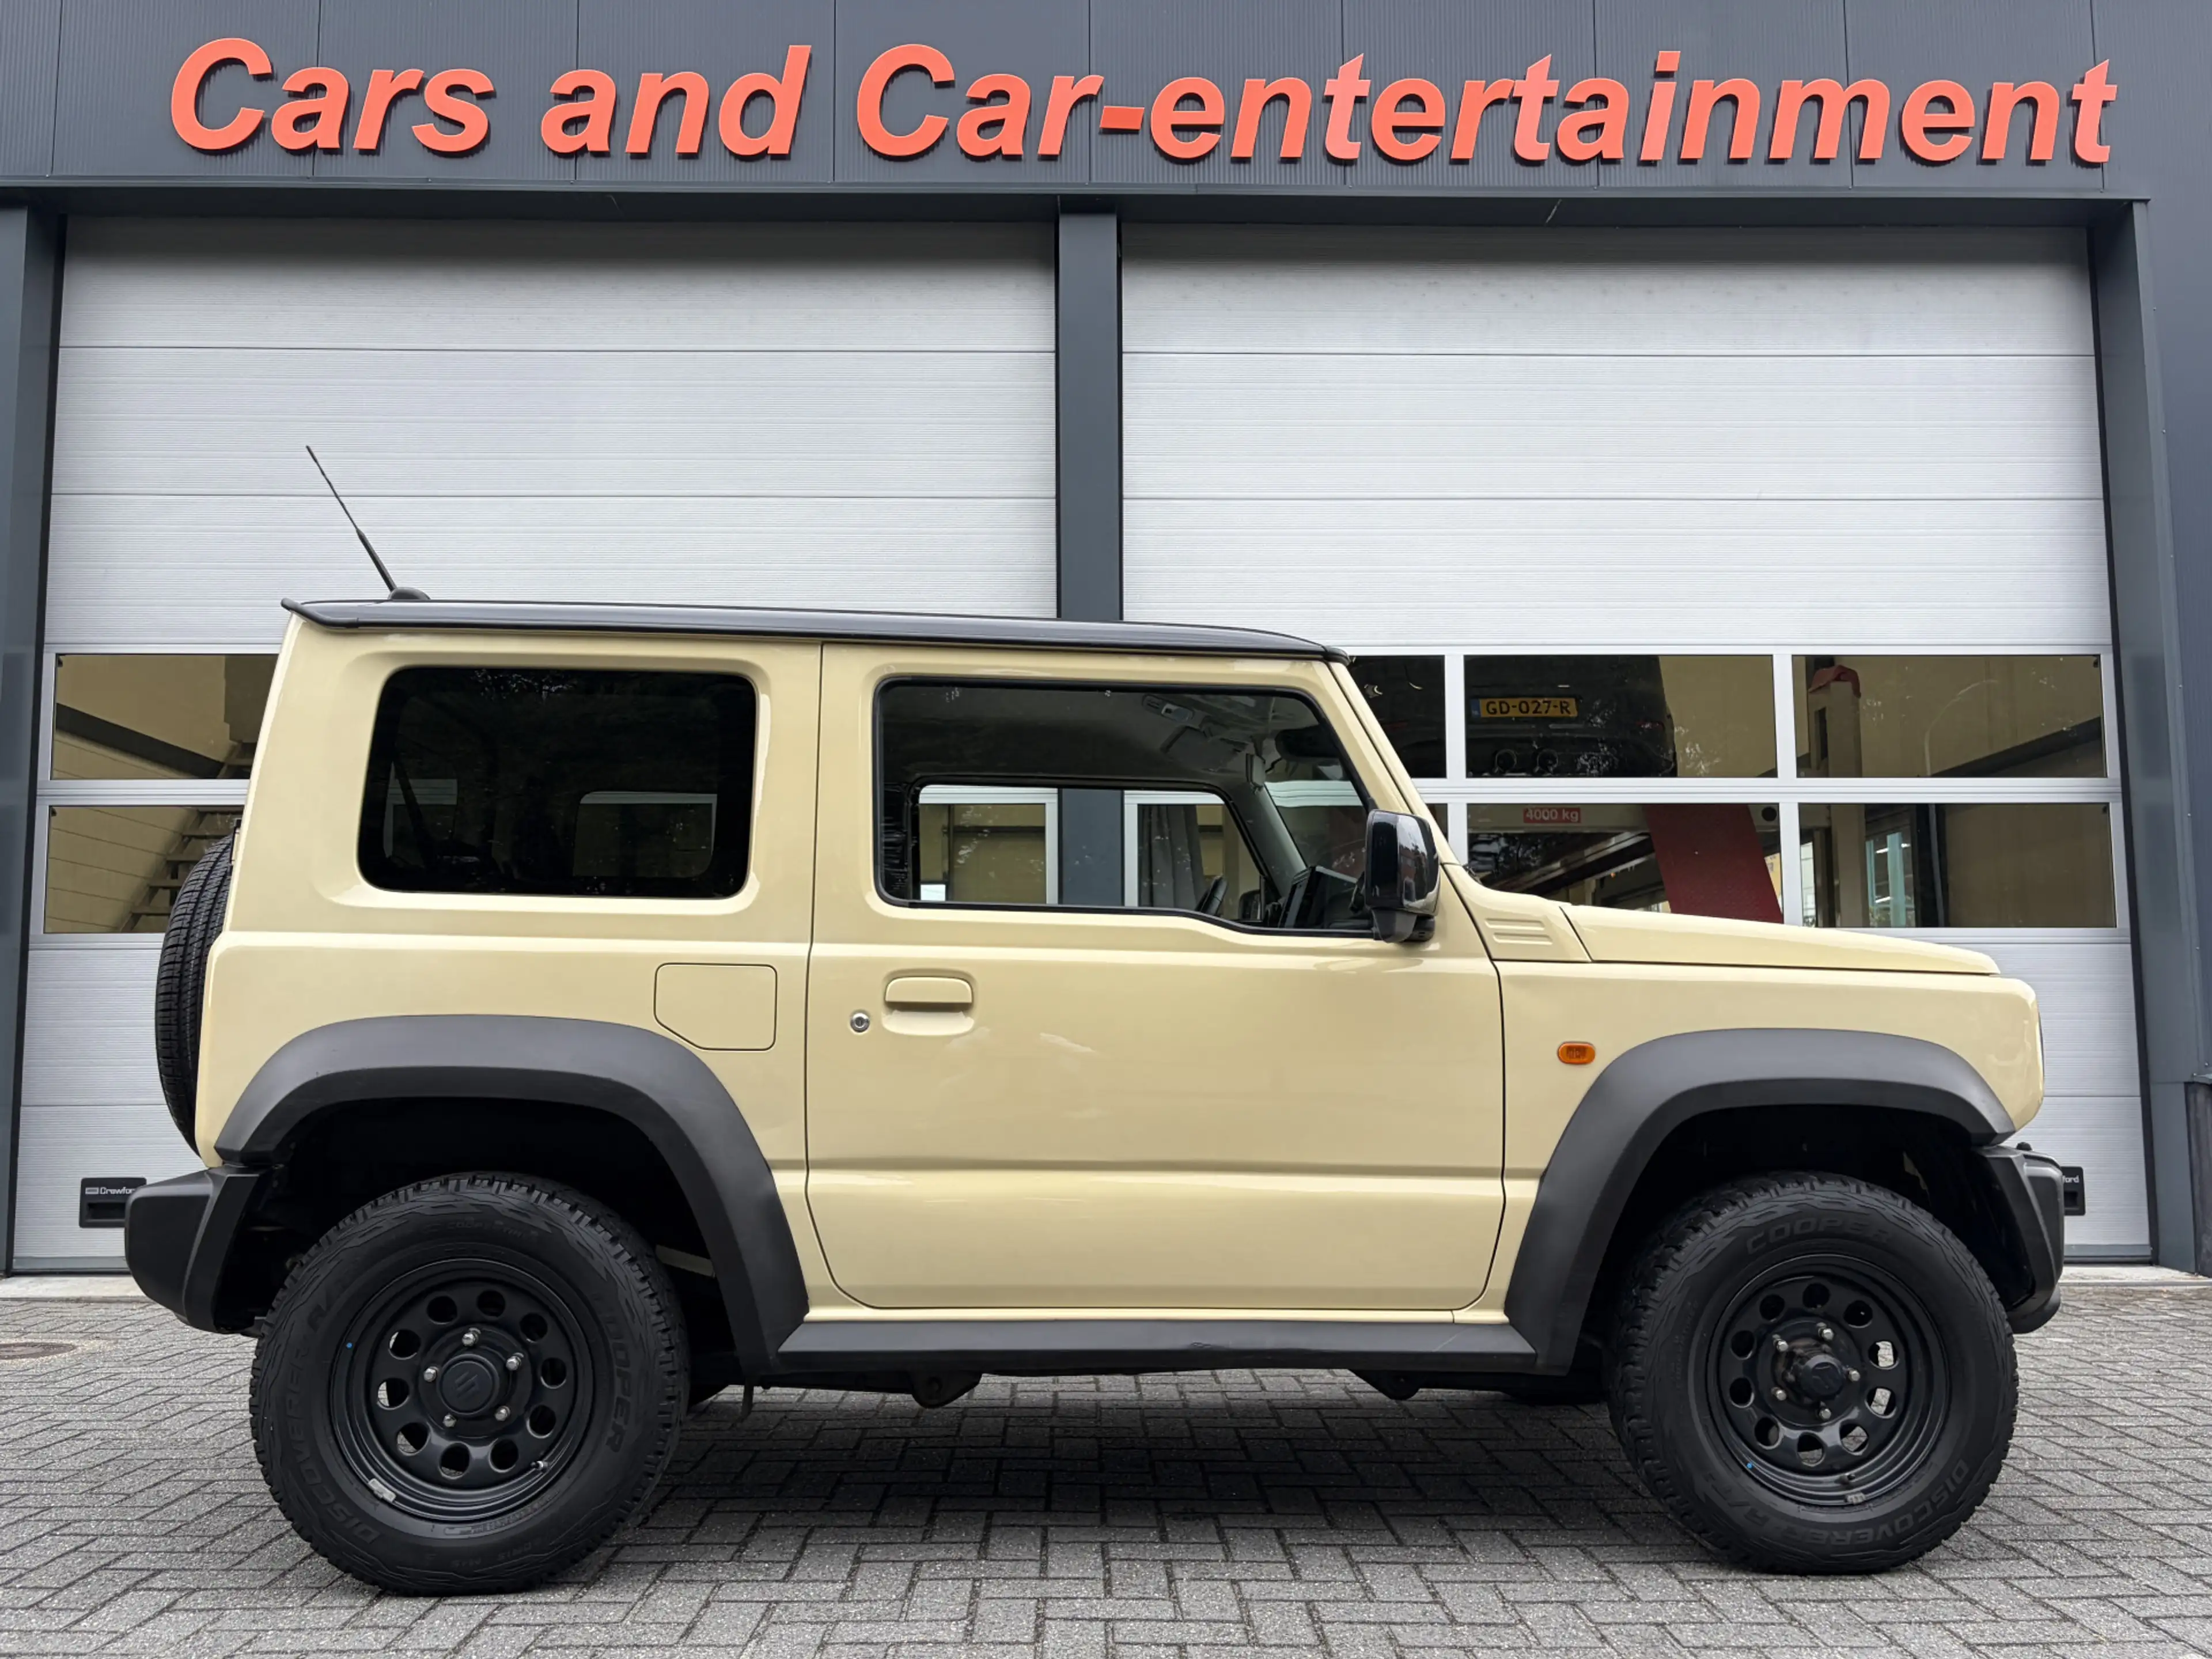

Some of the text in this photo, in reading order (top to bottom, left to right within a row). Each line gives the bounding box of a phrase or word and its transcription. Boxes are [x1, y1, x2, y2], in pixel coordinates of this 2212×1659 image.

[172, 39, 2116, 162] Cars and Car-entertainment
[1486, 699, 1571, 715] GD-027-R
[1525, 808, 1579, 823] 4000 kg
[100, 1186, 135, 1195] Crawfor
[1746, 1217, 1895, 1255] COOPER
[283, 1344, 381, 1544] DISCOVERER
